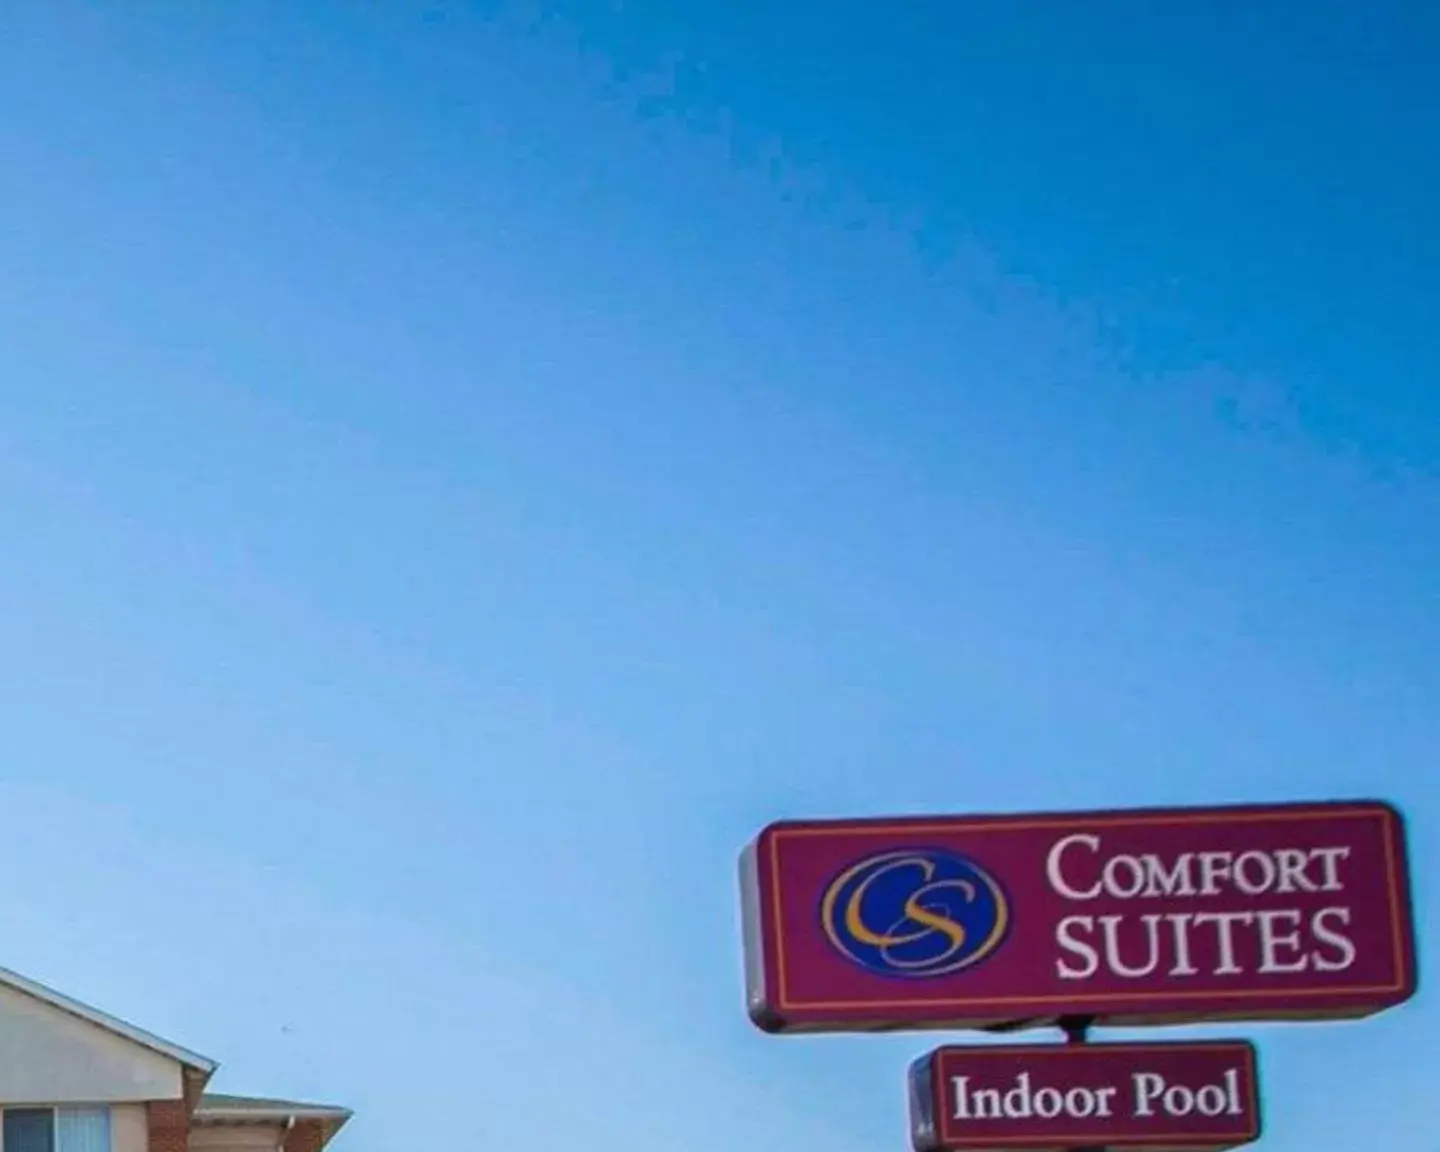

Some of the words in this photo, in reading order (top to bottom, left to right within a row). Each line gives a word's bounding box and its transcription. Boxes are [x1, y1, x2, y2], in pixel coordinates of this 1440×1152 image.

[1046, 834, 1351, 900] COMFORT
[1056, 908, 1356, 979] SUITES
[951, 1073, 1116, 1120] Indoor
[1132, 1069, 1244, 1118] Pool
